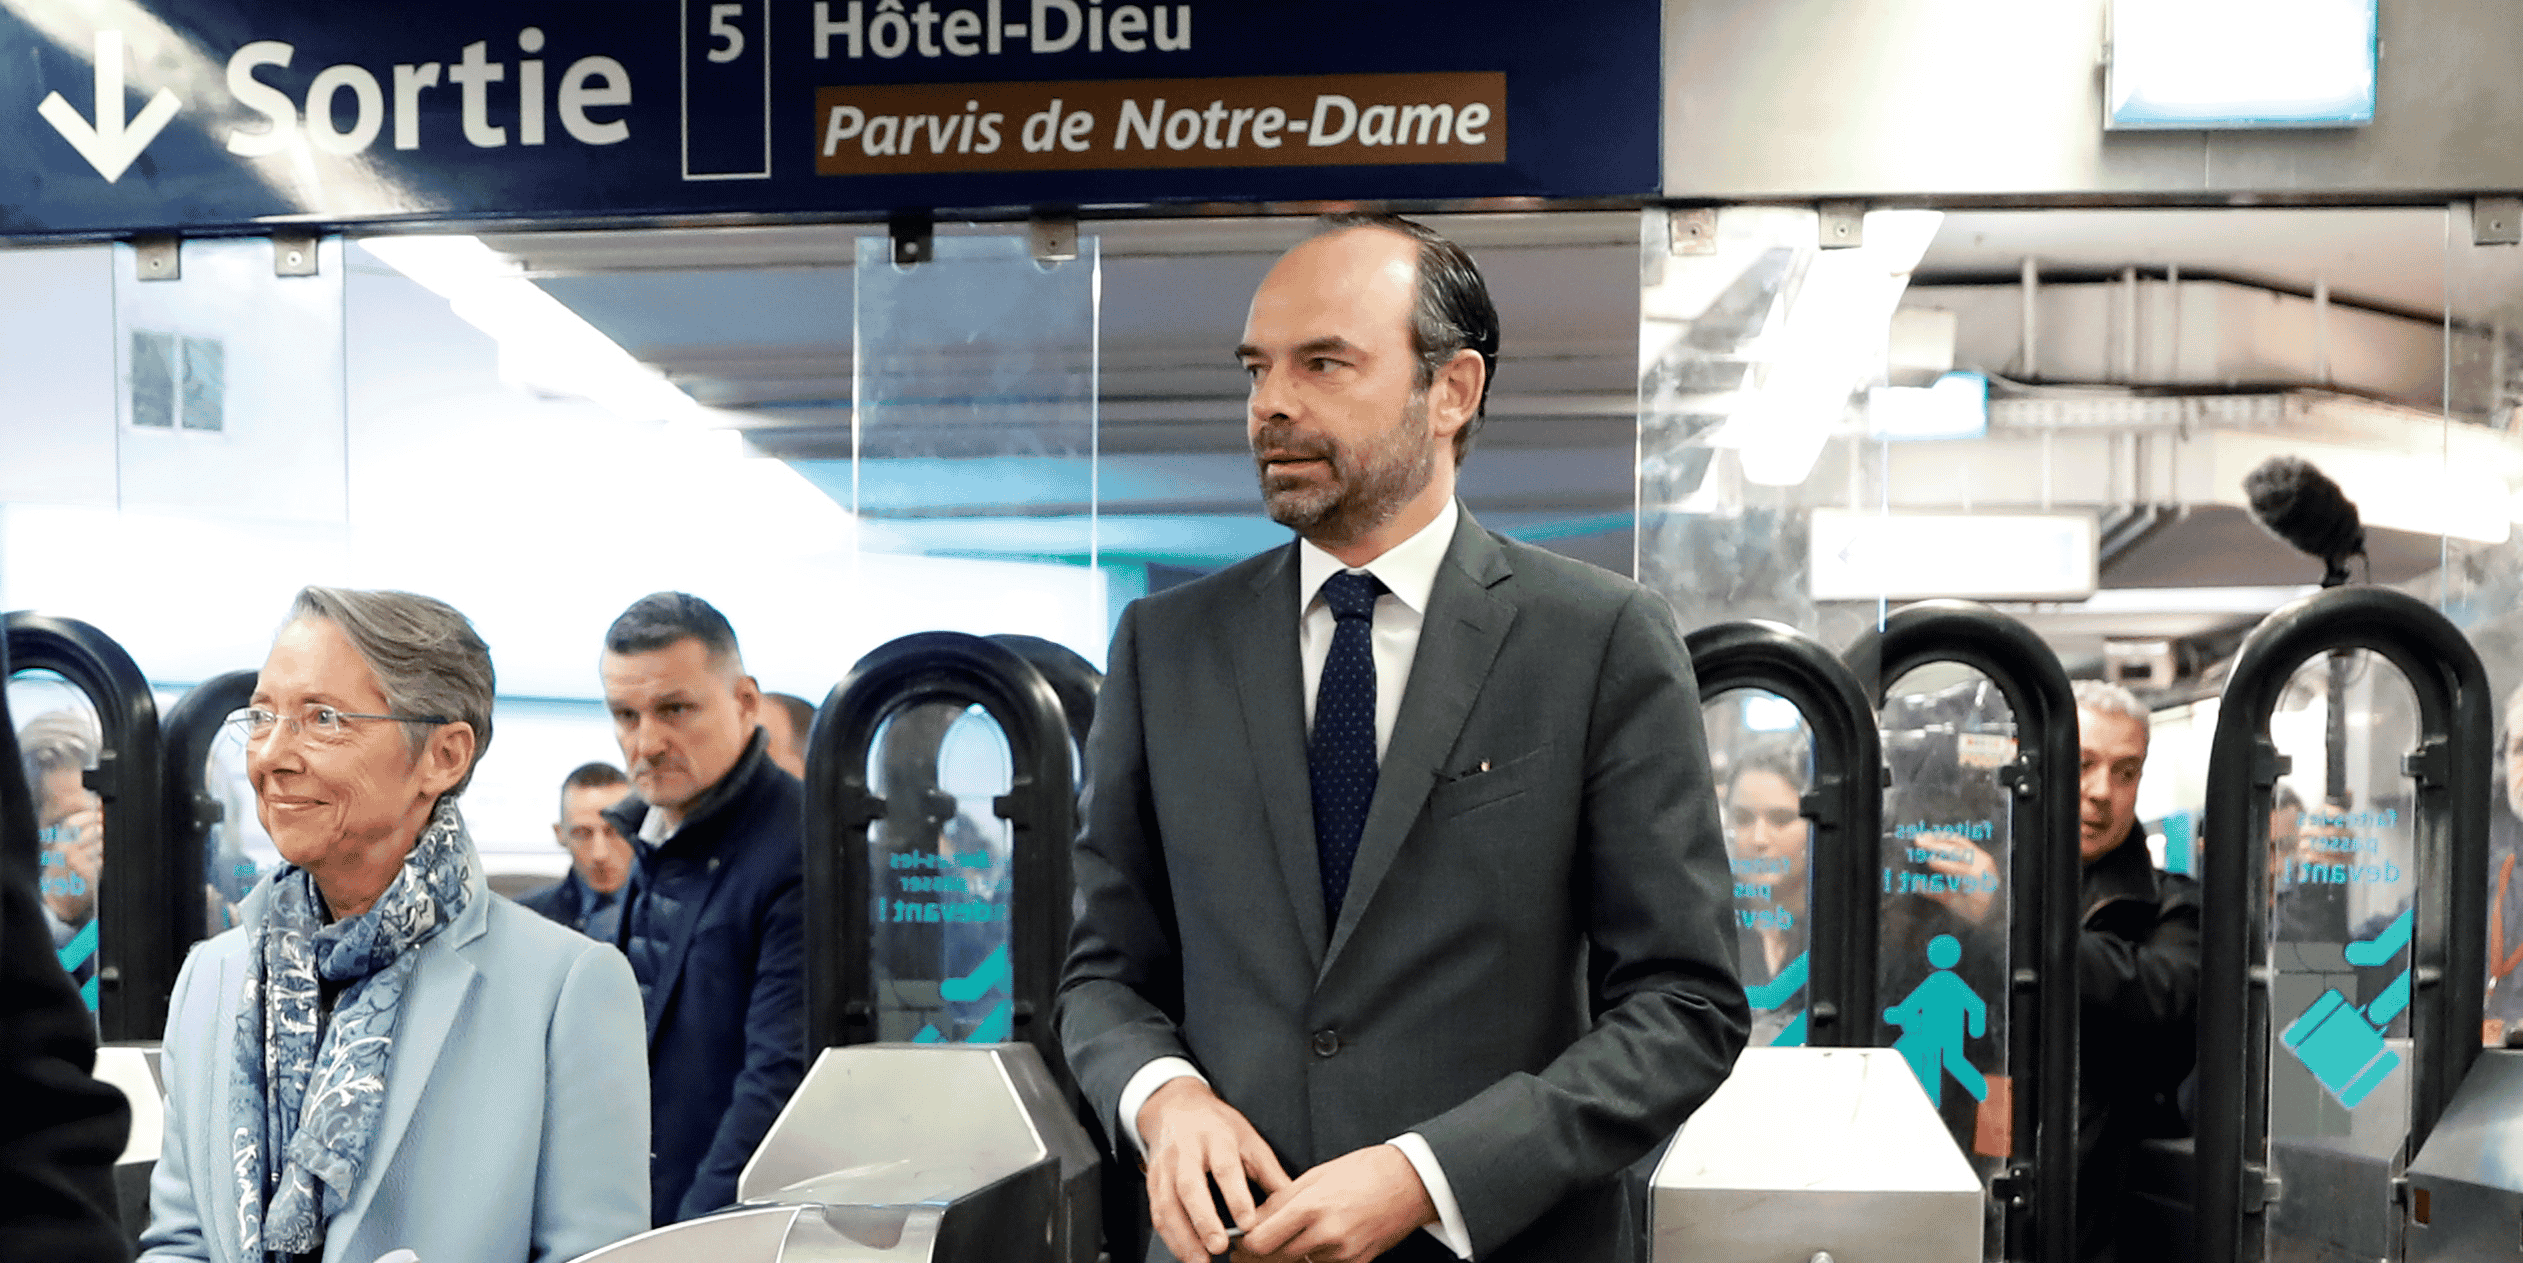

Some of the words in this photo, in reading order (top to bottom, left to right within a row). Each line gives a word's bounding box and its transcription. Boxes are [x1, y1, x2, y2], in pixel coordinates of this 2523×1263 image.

[707, 3, 747, 63] 5
[813, 0, 1191, 59] Hôtel-Dieu
[226, 26, 632, 158] Sortie
[822, 100, 1003, 157] Parvis
[1021, 98, 1095, 153] de
[1114, 95, 1491, 151] Notre-Dame
